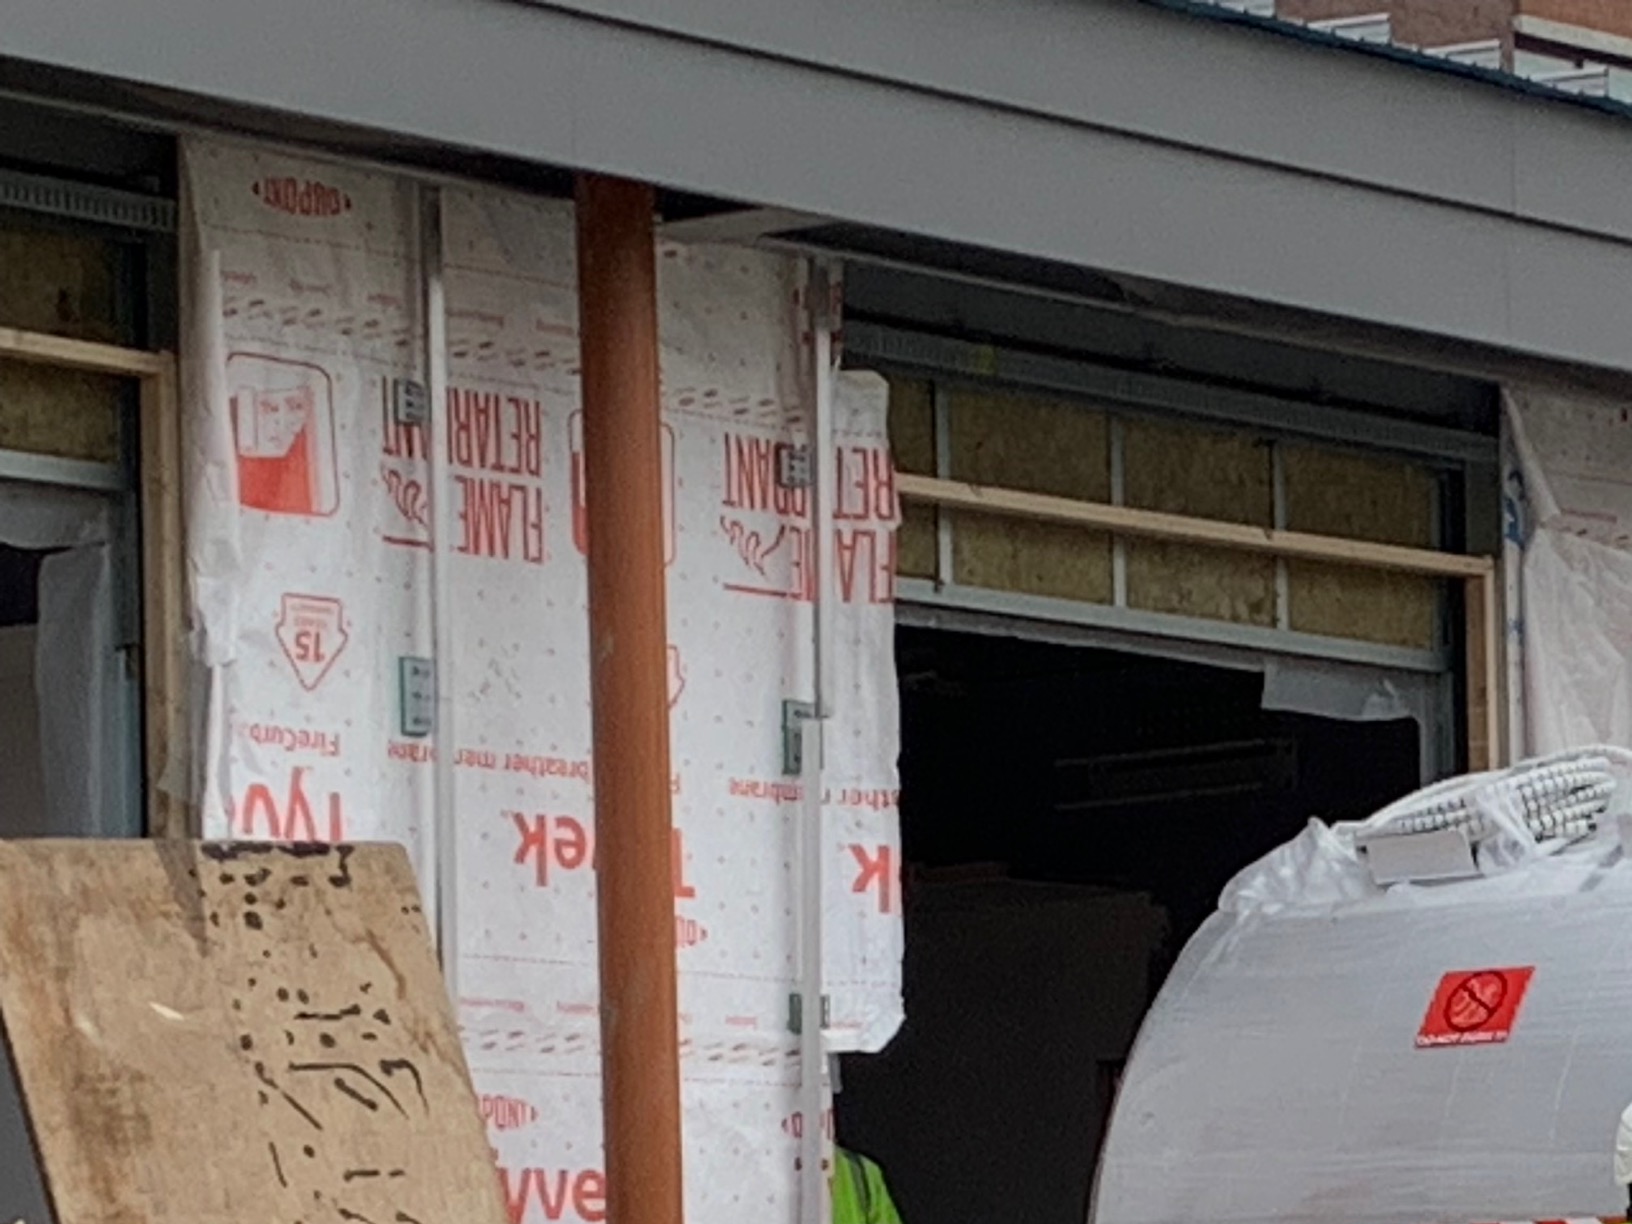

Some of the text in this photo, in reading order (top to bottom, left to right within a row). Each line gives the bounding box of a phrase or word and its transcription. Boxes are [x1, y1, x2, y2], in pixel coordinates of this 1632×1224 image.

[455, 474, 544, 565] FLAME
[293, 630, 327, 663] 15
[504, 750, 591, 785] breather
